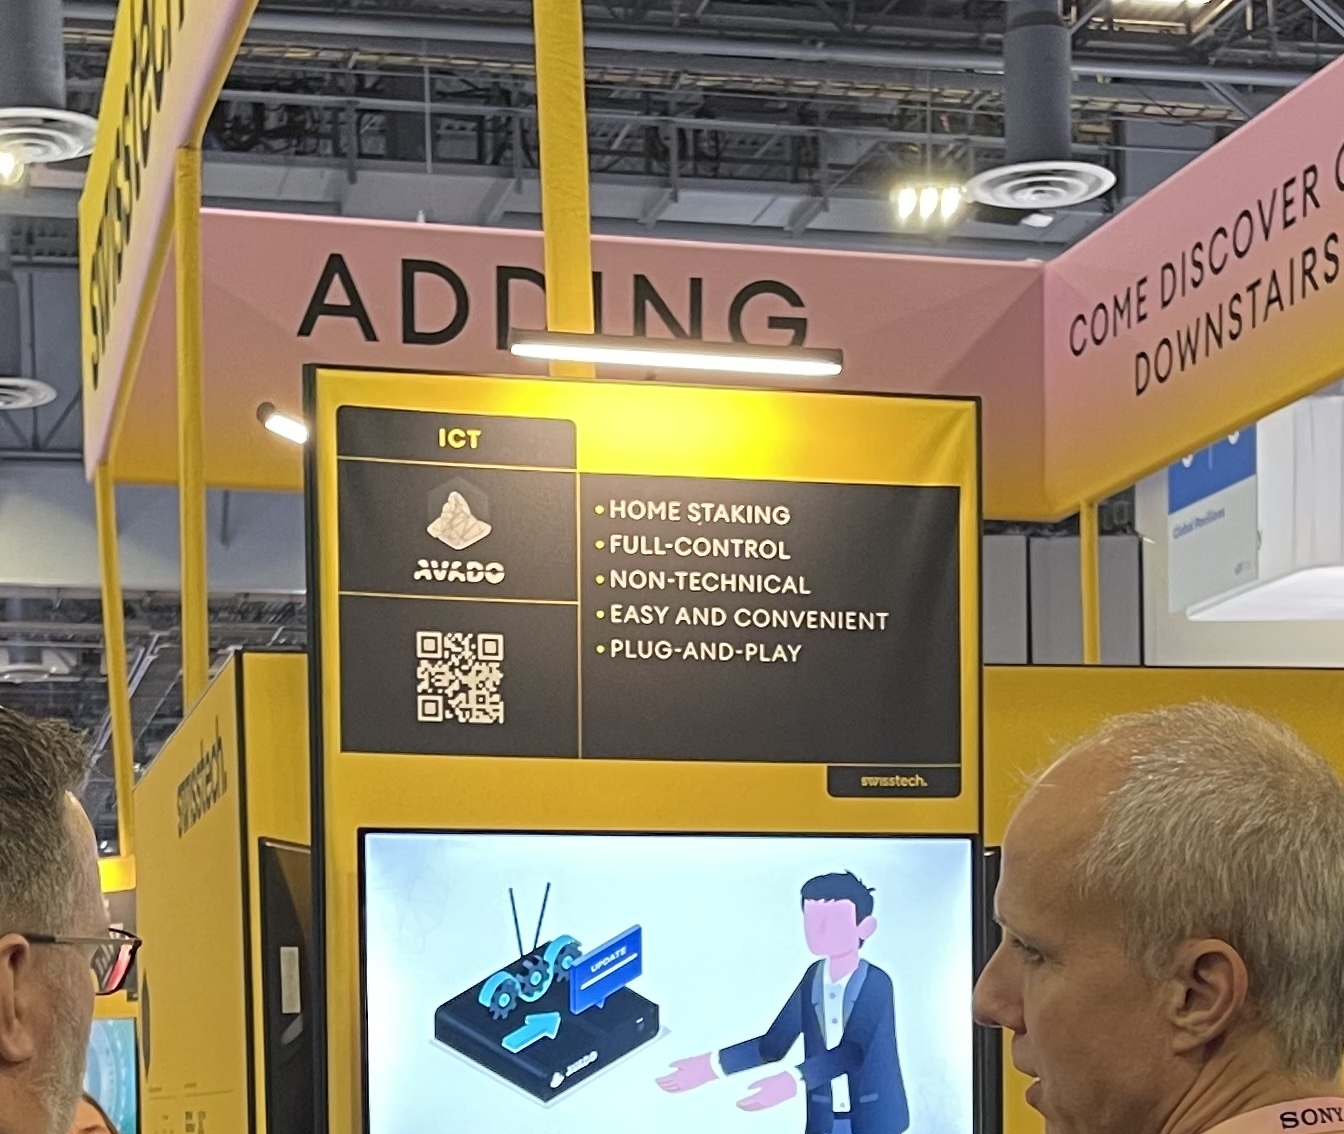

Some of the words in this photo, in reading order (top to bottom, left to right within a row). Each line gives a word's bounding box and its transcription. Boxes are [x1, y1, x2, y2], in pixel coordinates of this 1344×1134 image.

[91, 0, 185, 391] swisstec
[1069, 275, 1149, 357] COME
[1160, 164, 1321, 309] DISCOVER
[296, 252, 809, 350] ADDING
[1135, 231, 1340, 397] DOWNSTAIRS
[438, 427, 482, 449] ICT
[609, 499, 681, 522] HOME
[687, 502, 791, 526] STAKING
[609, 534, 791, 560] FULL-CONTROL
[413, 559, 506, 585] AVADO
[609, 569, 812, 595] NON-TECHNICAL
[609, 604, 669, 625] EASY
[675, 606, 727, 627] AND
[733, 608, 889, 631] CONVENIENT
[609, 638, 803, 663] PLUG-AND-PLAY
[861, 775, 928, 788] swisstech.
[590, 946, 627, 973] UPDATE
